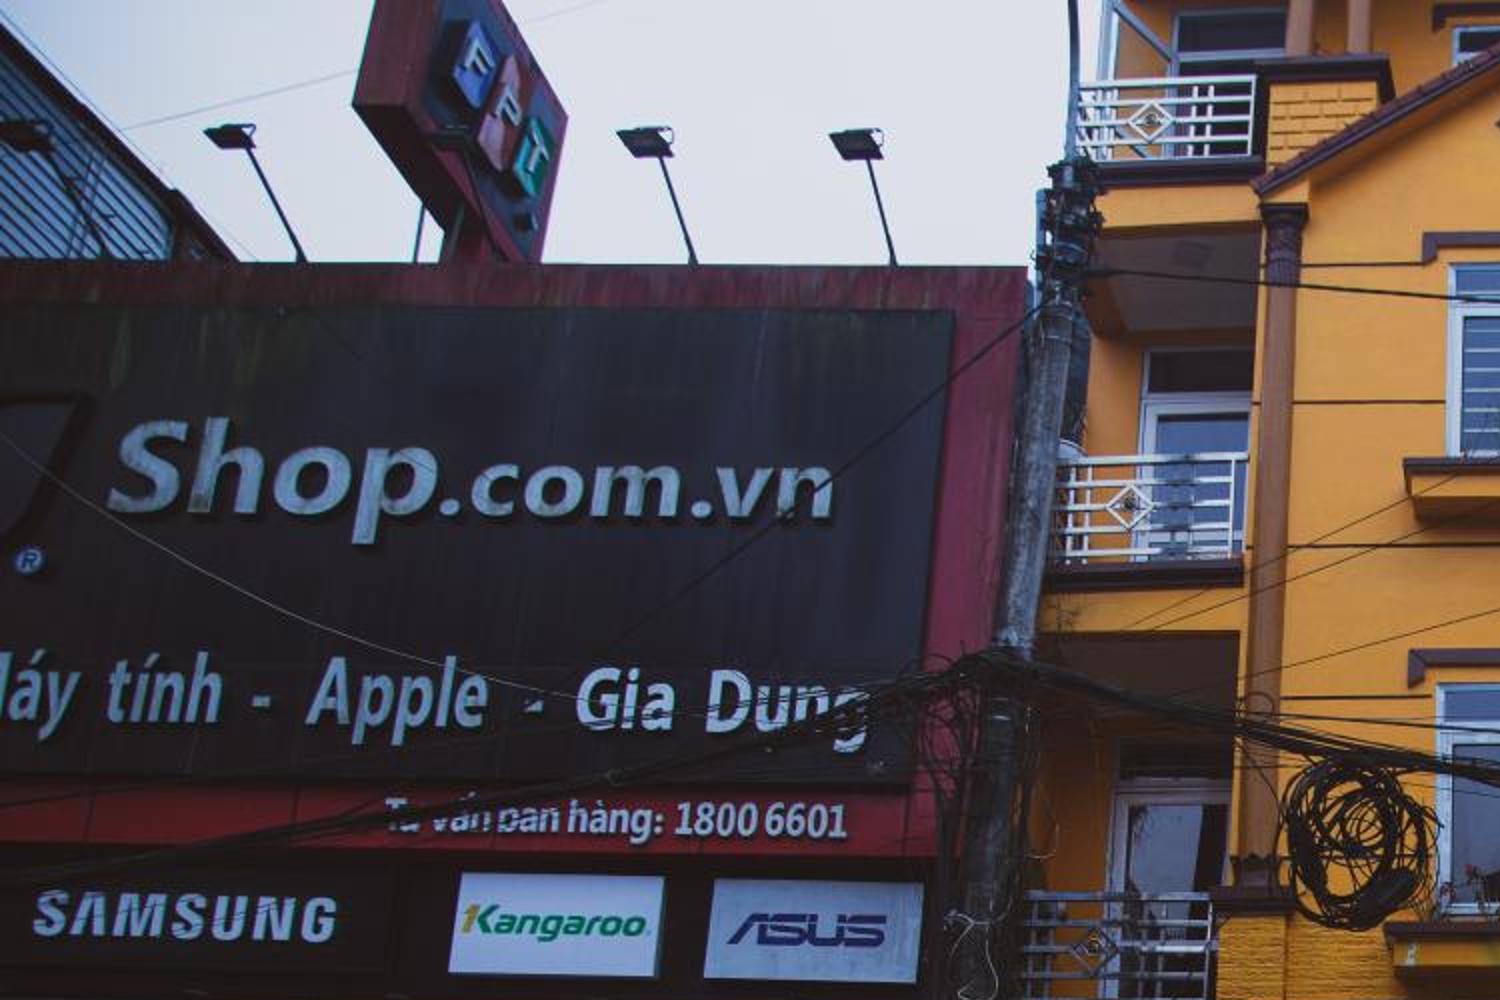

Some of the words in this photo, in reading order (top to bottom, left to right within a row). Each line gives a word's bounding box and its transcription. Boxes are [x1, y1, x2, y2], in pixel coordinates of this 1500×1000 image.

[458, 38, 550, 176] FPT
[107, 417, 836, 545] Shop.com.vn
[107, 651, 224, 723] tính
[305, 655, 488, 745] Apple
[576, 667, 674, 732] Gia
[567, 798, 664, 845] hàng:
[676, 802, 757, 836] 1800
[765, 802, 847, 838] 6601
[33, 889, 336, 943] SAMSUNG
[727, 914, 886, 947] ASUS
